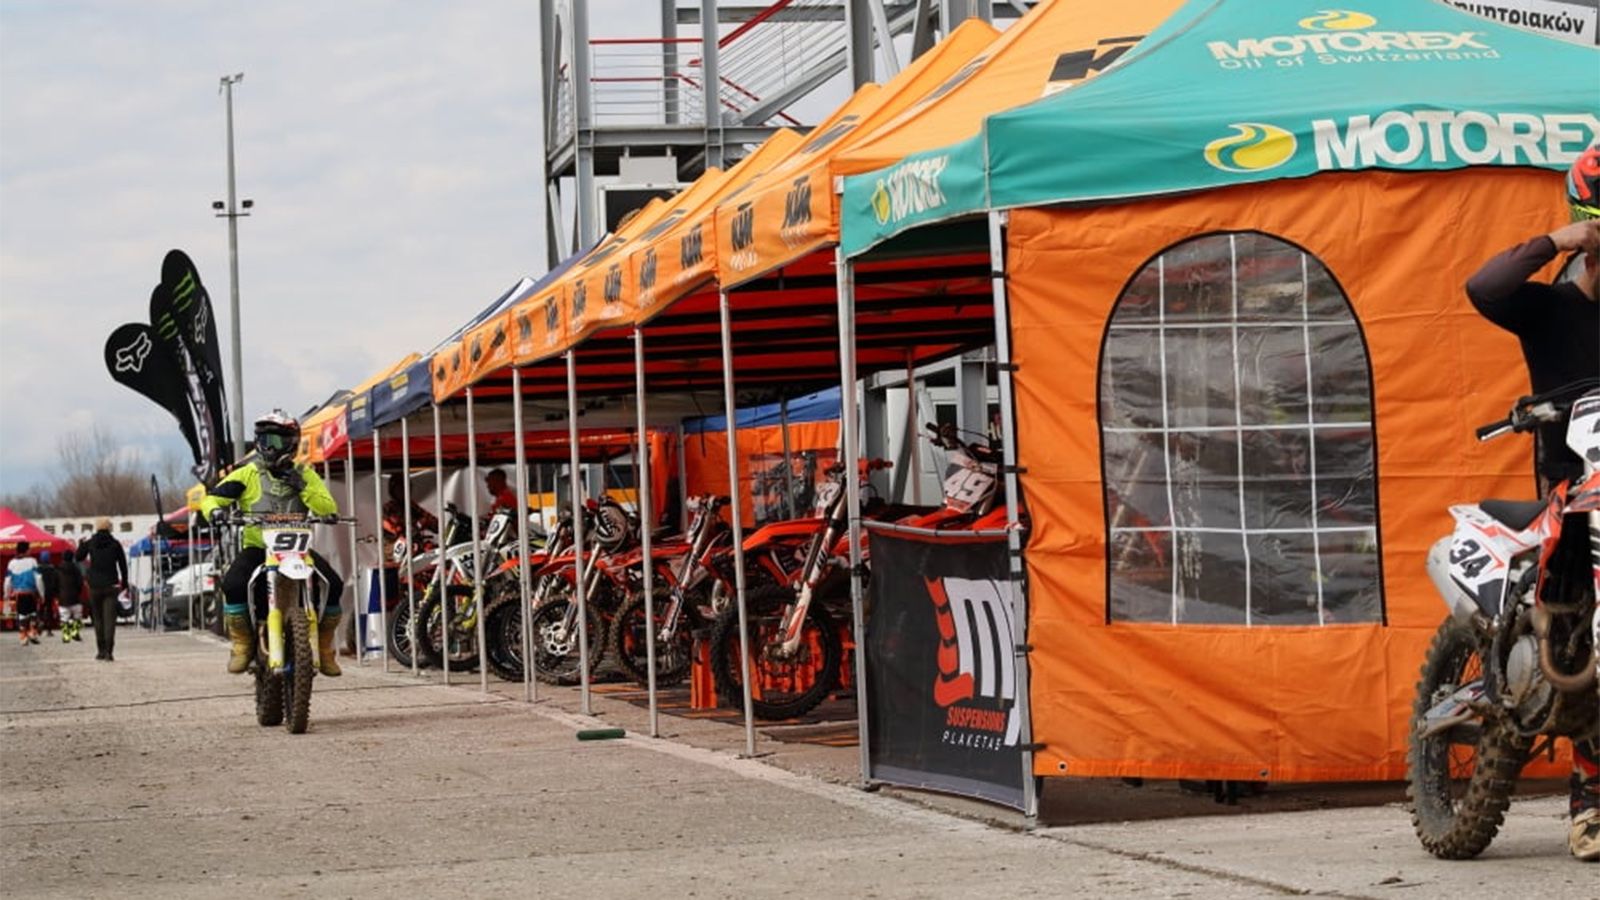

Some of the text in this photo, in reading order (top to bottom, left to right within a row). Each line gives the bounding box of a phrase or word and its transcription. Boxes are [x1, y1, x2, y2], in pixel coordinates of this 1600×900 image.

[1206, 31, 1490, 60] MOTOREX
[1219, 49, 1501, 70] Oil of Switzerland
[781, 175, 812, 230] KTM
[888, 154, 949, 223] MOTOREX
[731, 201, 753, 252] KTM
[272, 533, 310, 552] 91
[1449, 538, 1492, 578] 34
[942, 730, 1002, 751] PLAKETAS
